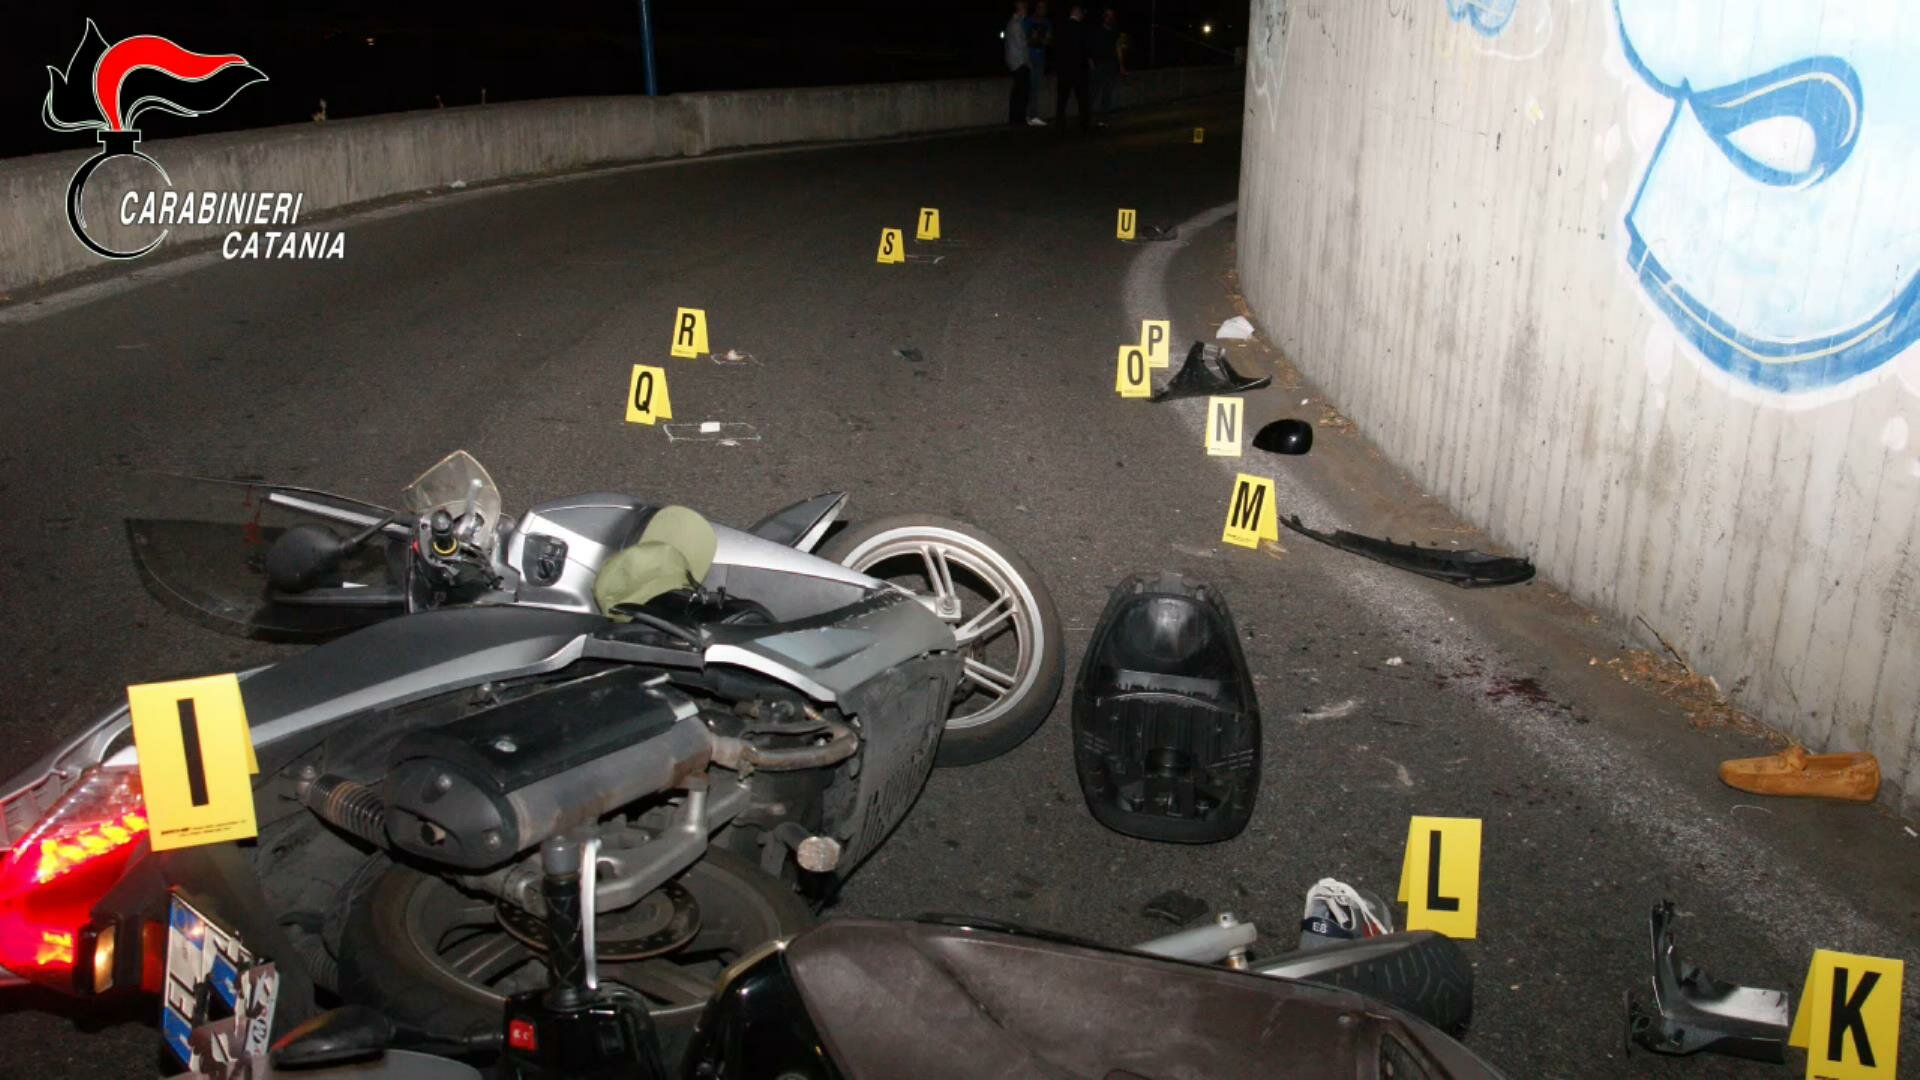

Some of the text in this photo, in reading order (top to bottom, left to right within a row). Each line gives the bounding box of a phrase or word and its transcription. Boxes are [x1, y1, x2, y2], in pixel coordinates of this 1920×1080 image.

[924, 211, 934, 232] T
[1121, 212, 1132, 233] U
[883, 231, 895, 256] S
[678, 313, 697, 347] R
[1147, 325, 1163, 356] P
[1126, 349, 1144, 386] O
[634, 371, 653, 414] Q
[1215, 402, 1236, 443] N
[1230, 480, 1267, 532] M
[1426, 830, 1460, 912] L
[1826, 966, 1883, 1069] K
